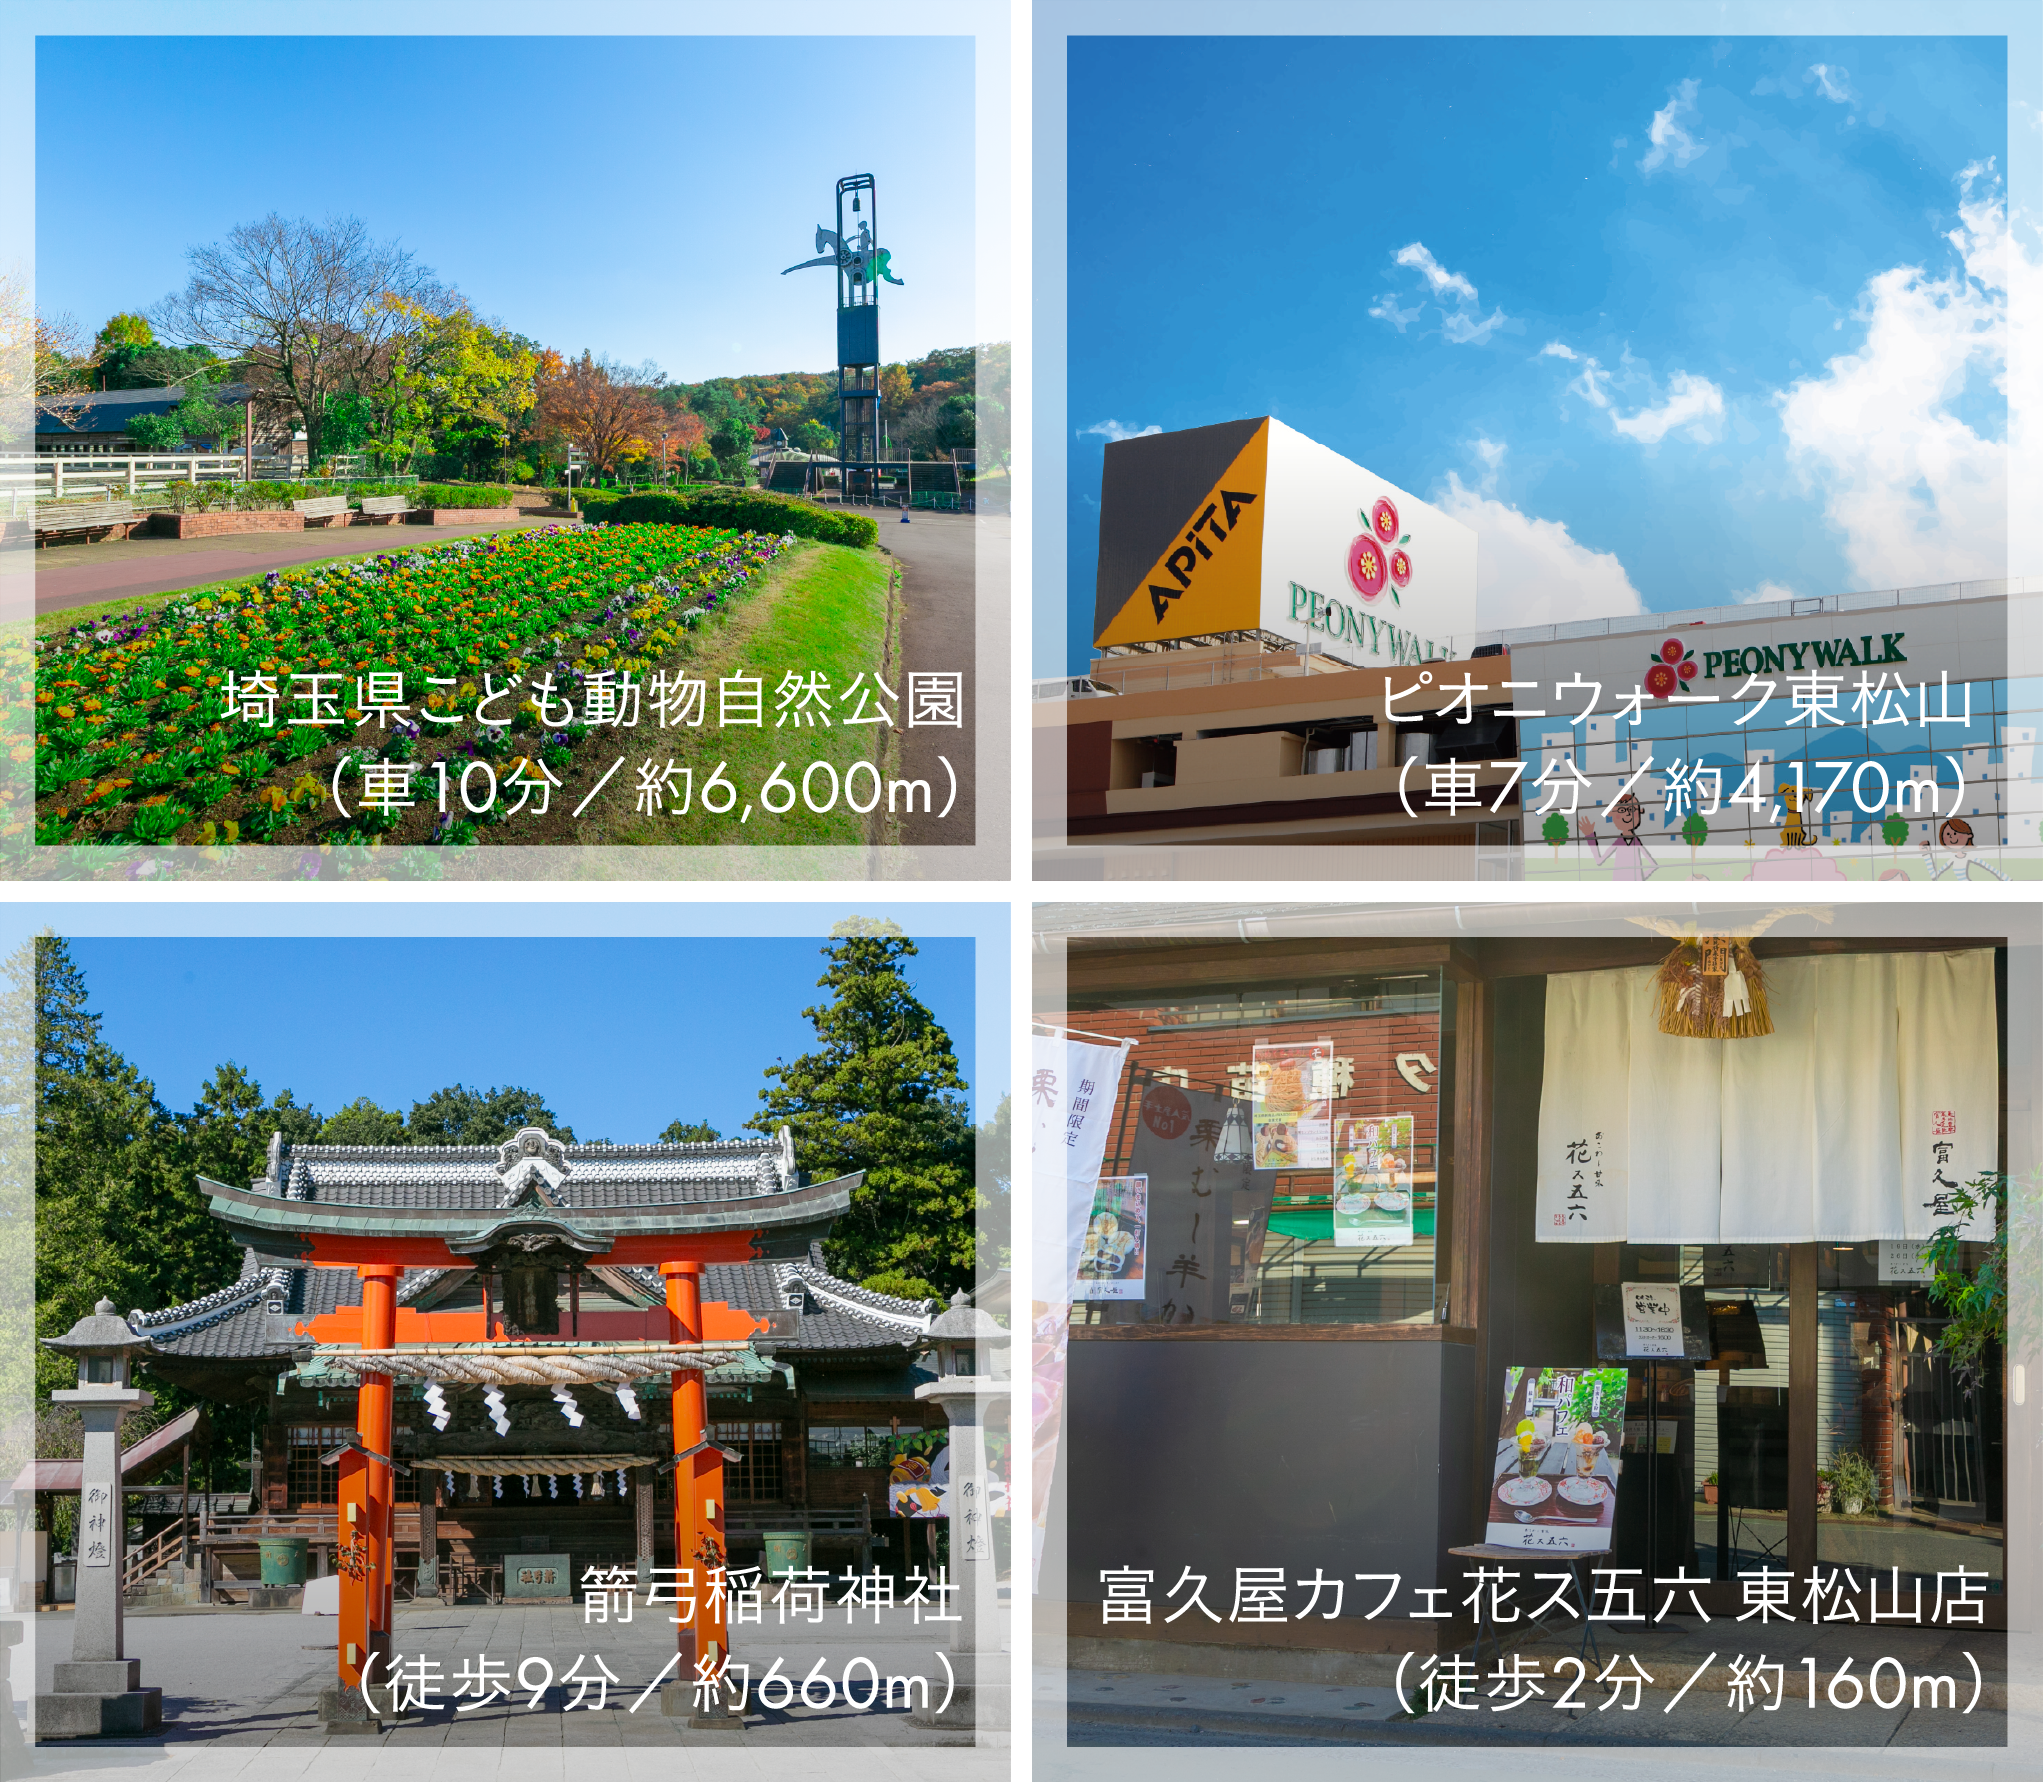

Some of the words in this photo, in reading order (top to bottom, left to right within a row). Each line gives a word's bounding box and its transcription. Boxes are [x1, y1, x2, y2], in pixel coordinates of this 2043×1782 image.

[1703, 632, 1907, 679] PEONYWALK
[1061, 1078, 1096, 1148] 期間限定
[1565, 1138, 1592, 1221] 花ス五六
[1922, 1140, 1958, 1216] 富久屋
[1554, 1375, 1575, 1437] 和パフェ
[1522, 1532, 1569, 1546] 花ス五六
